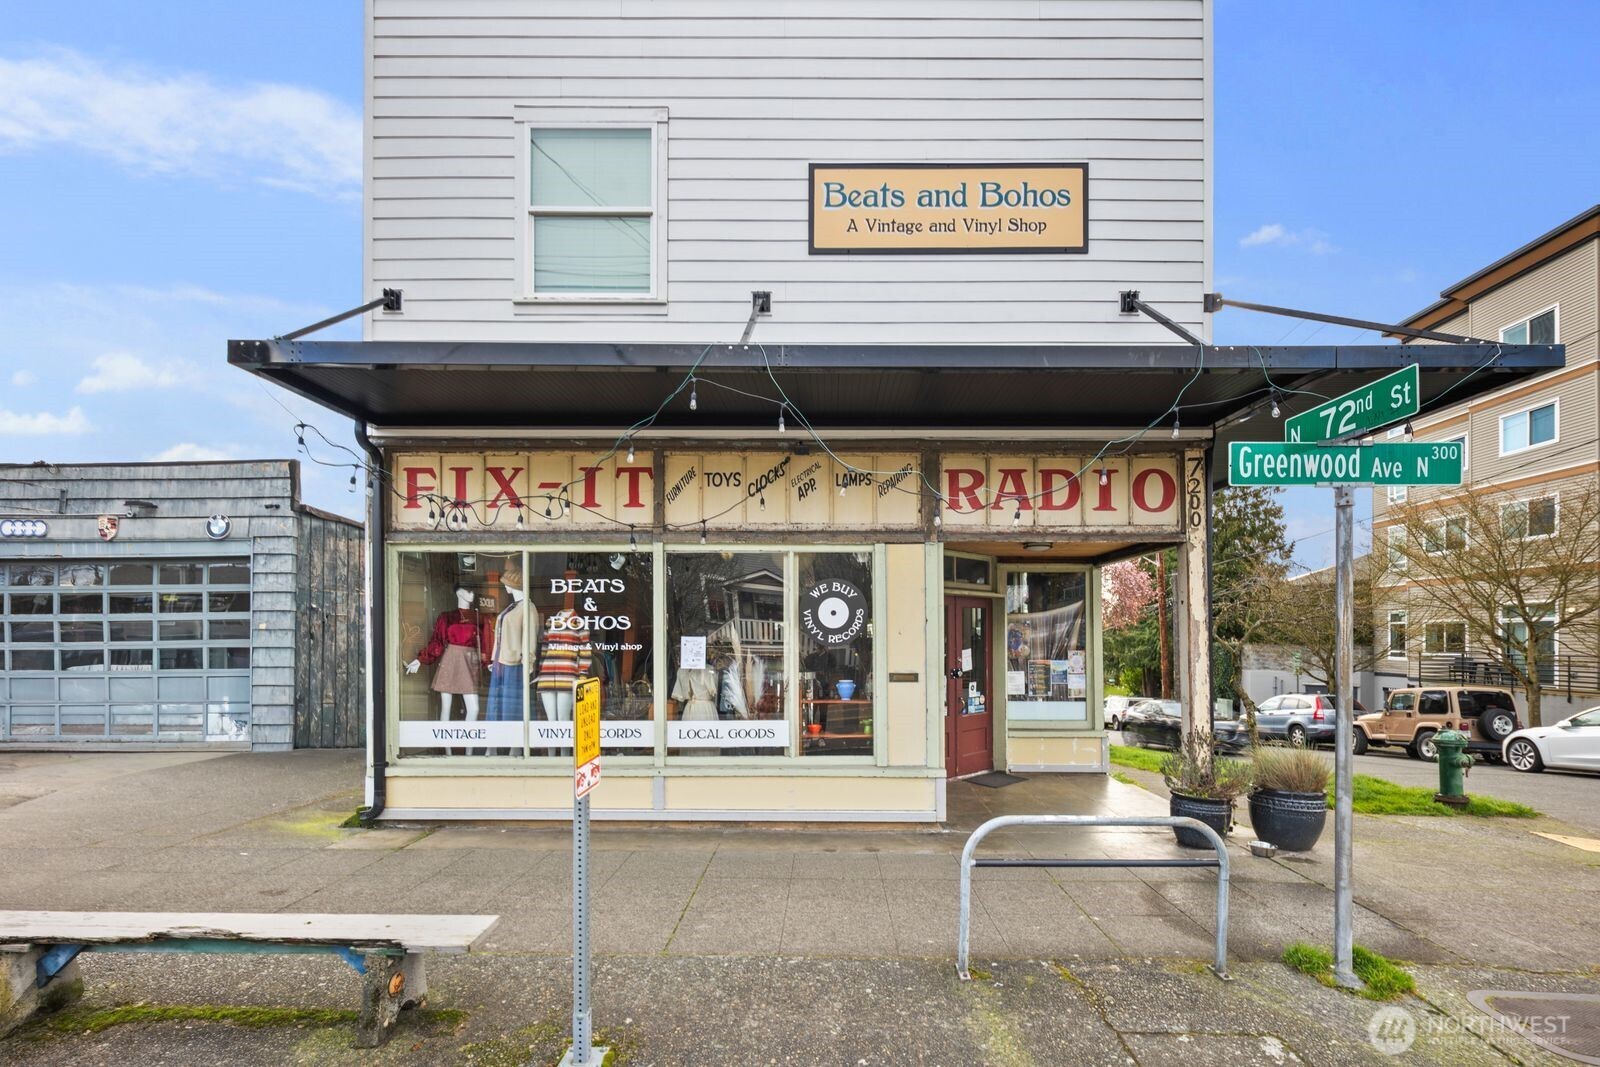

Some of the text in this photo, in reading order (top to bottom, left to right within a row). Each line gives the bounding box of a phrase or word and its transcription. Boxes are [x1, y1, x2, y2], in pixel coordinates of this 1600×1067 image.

[824, 182, 1071, 208] Beats and Bohos
[847, 218, 1047, 236] A Vintage and Vinyl Shop
[1290, 425, 1301, 442] N
[1319, 390, 1373, 439] 72nd
[1390, 381, 1411, 409] St
[791, 461, 822, 487] ELECTRICAL
[1239, 446, 1458, 479] Greenwood Ave N 300
[402, 467, 654, 509] FIX-IT
[666, 466, 697, 504] FURNITURE
[704, 472, 741, 487] TOYS
[748, 461, 786, 497] CLOCKS
[797, 477, 817, 501] APP.
[835, 472, 872, 487] LAMPS
[878, 463, 913, 498] REPAIRING
[944, 468, 1176, 512] RADIO
[1187, 457, 1203, 527] 7200
[550, 579, 625, 594] BEATS
[809, 582, 858, 599] WE BUY
[584, 597, 598, 612] &
[550, 616, 631, 631] BOHOS
[803, 608, 864, 643] VINYL RECORDS
[548, 643, 585, 652] Vintage
[595, 643, 619, 652] Vinyl
[621, 643, 643, 652] shop
[432, 728, 486, 740] VINTAGE
[538, 728, 642, 739] VINYL CORDS
[678, 728, 776, 740] LOCAL GOODS
